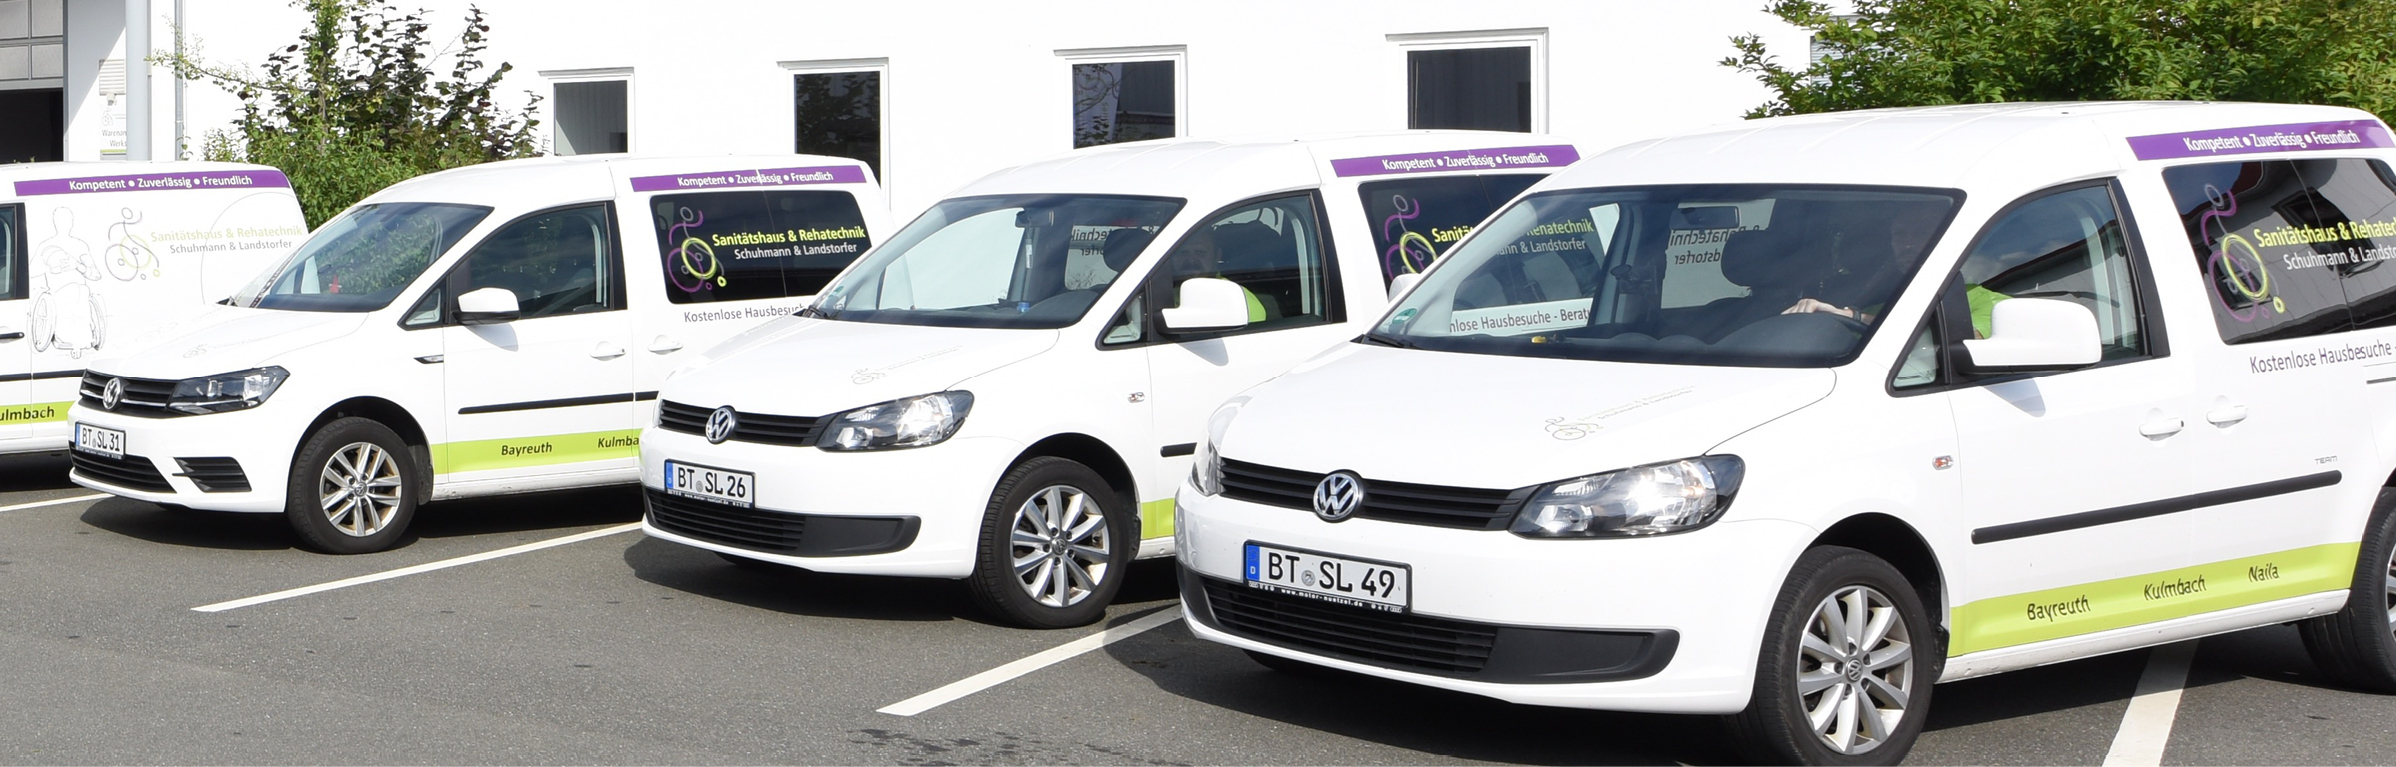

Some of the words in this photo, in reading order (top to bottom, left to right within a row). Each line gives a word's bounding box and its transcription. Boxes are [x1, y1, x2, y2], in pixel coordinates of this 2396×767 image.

[2183, 135, 2243, 153] Kompetent
[2249, 131, 2306, 149] Zuverlässig
[2311, 129, 2360, 146] Freundlich
[1382, 157, 1436, 172] Kompetent
[1443, 153, 1496, 168] Zuverlässig
[1503, 151, 1549, 165] Freundlich
[69, 179, 126, 191] Kompetent
[137, 176, 192, 188] Zuverlässig
[202, 175, 253, 186] Freundlich
[677, 175, 727, 188] Kompetent
[735, 172, 783, 185] Zuverlässig
[790, 170, 833, 183] Freundlich
[150, 228, 224, 242] Sanitätshaus
[226, 228, 235, 239] &
[237, 225, 302, 238] Rehatechnik
[712, 230, 786, 247] Sanitätshaus
[788, 229, 797, 242] &
[799, 226, 866, 241] Rehatechnik
[2253, 223, 2338, 248] Sanitätshaus
[2337, 221, 2352, 241] &
[169, 242, 227, 254] Schuhmann
[229, 241, 236, 251] &
[238, 239, 292, 250] Landstorfer
[734, 245, 791, 260] Schuhmann
[794, 244, 802, 257] &
[803, 242, 858, 256] Landstorfer
[1520, 241, 1529, 254] &
[1530, 237, 1586, 253] Landstorfer
[2283, 251, 2349, 270] Schuhmann
[2348, 246, 2359, 264] &
[684, 308, 742, 323] Kostenlose
[1480, 310, 1551, 329] Hausbesuche
[2249, 350, 2317, 374] Kostenlose
[2318, 339, 2392, 365] Hausbesuche
[82, 427, 92, 446] BT
[97, 430, 107, 450] SL
[109, 432, 120, 452] 31
[501, 441, 553, 457] Bayreuth
[597, 435, 640, 449] Kulmba
[2314, 455, 2338, 465] TEAM
[678, 466, 695, 490] BT
[705, 471, 723, 495] SL
[727, 475, 746, 498] 26
[1268, 551, 1300, 583] BT
[1318, 560, 1353, 593] SL
[1361, 567, 1395, 598] 49
[2026, 594, 2091, 623] Bayreuth
[2143, 574, 2207, 602] Kulmbach
[2248, 562, 2280, 583] Naila
